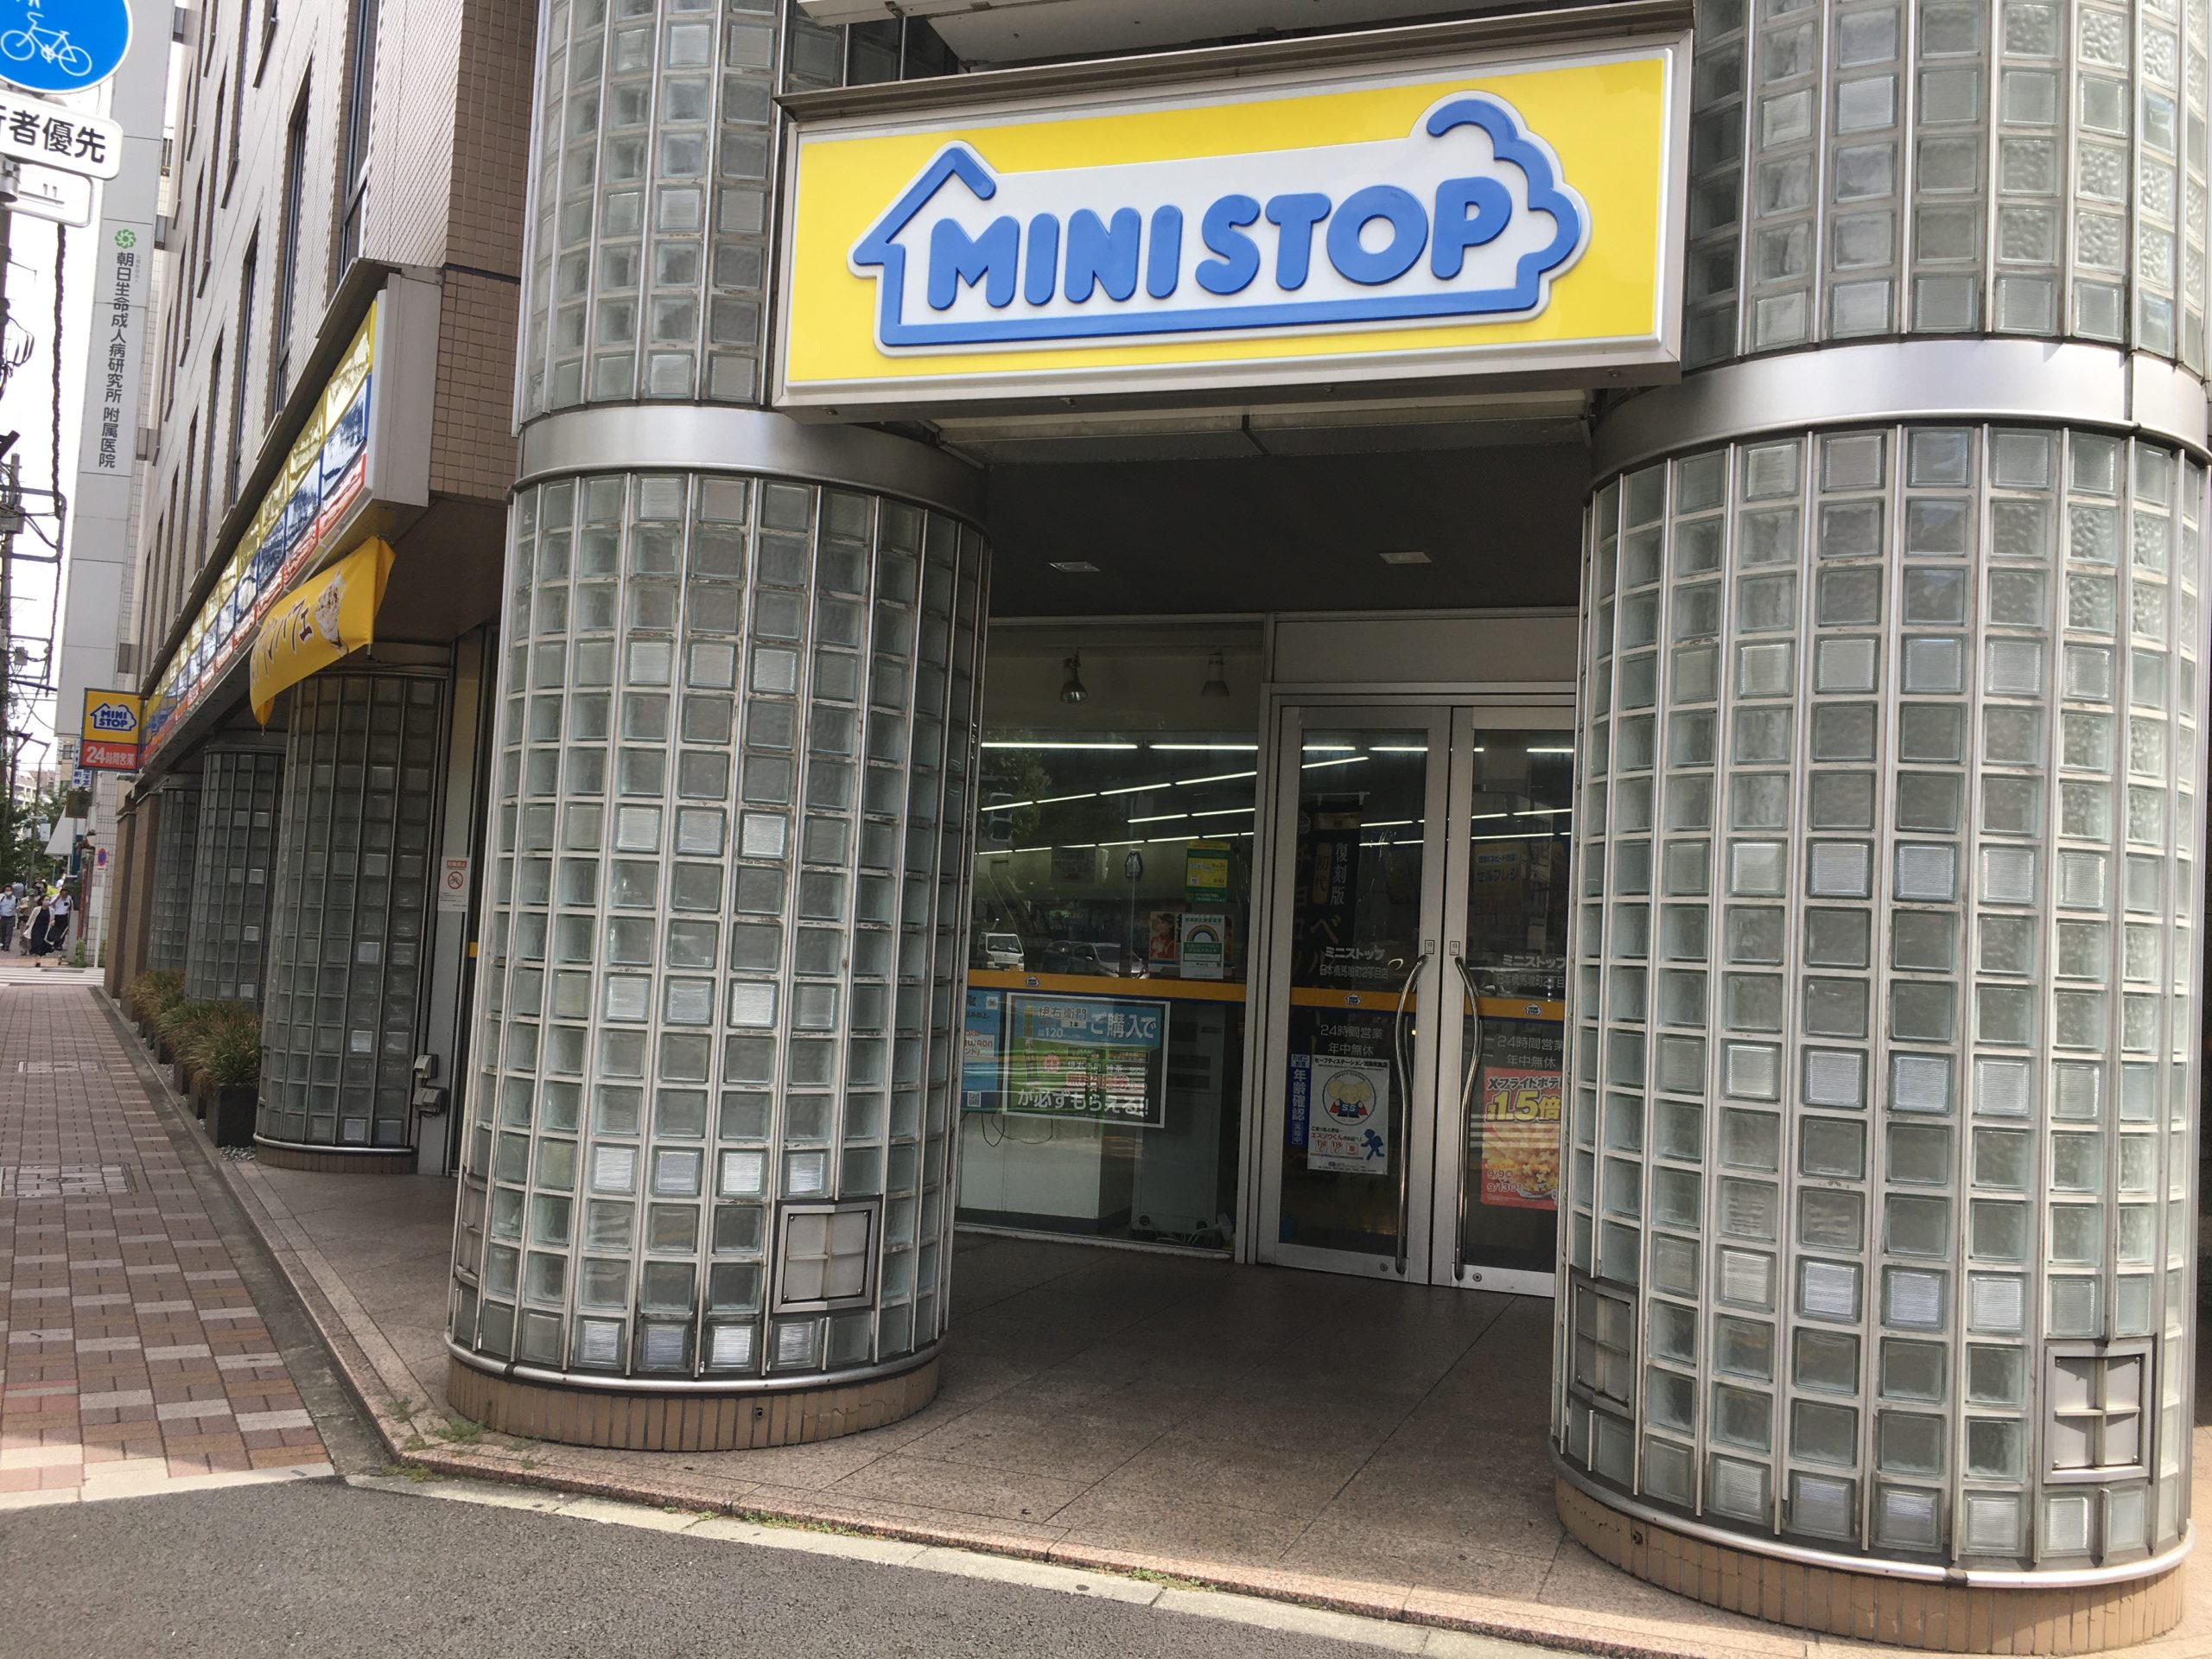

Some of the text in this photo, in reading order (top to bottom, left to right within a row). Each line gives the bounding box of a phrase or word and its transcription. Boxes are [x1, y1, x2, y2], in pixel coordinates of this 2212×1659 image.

[0, 105, 105, 164] 者優先
[99, 251, 135, 468] 朝日生命成人病研究所 附属医院
[100, 709, 128, 720] MINI
[99, 718, 129, 728] STOP
[1330, 842, 1349, 906] 復刻版
[1325, 945, 1386, 961] ミニストップ
[1039, 1006, 1088, 1020] 伊右衛門
[1090, 1011, 1157, 1039] ご購入で
[1320, 1024, 1383, 1039] 24時間営業
[1328, 1042, 1375, 1056] 年中無休
[1507, 1054, 1556, 1069] 年中無休
[1292, 1068, 1306, 1121] 年齢確認
